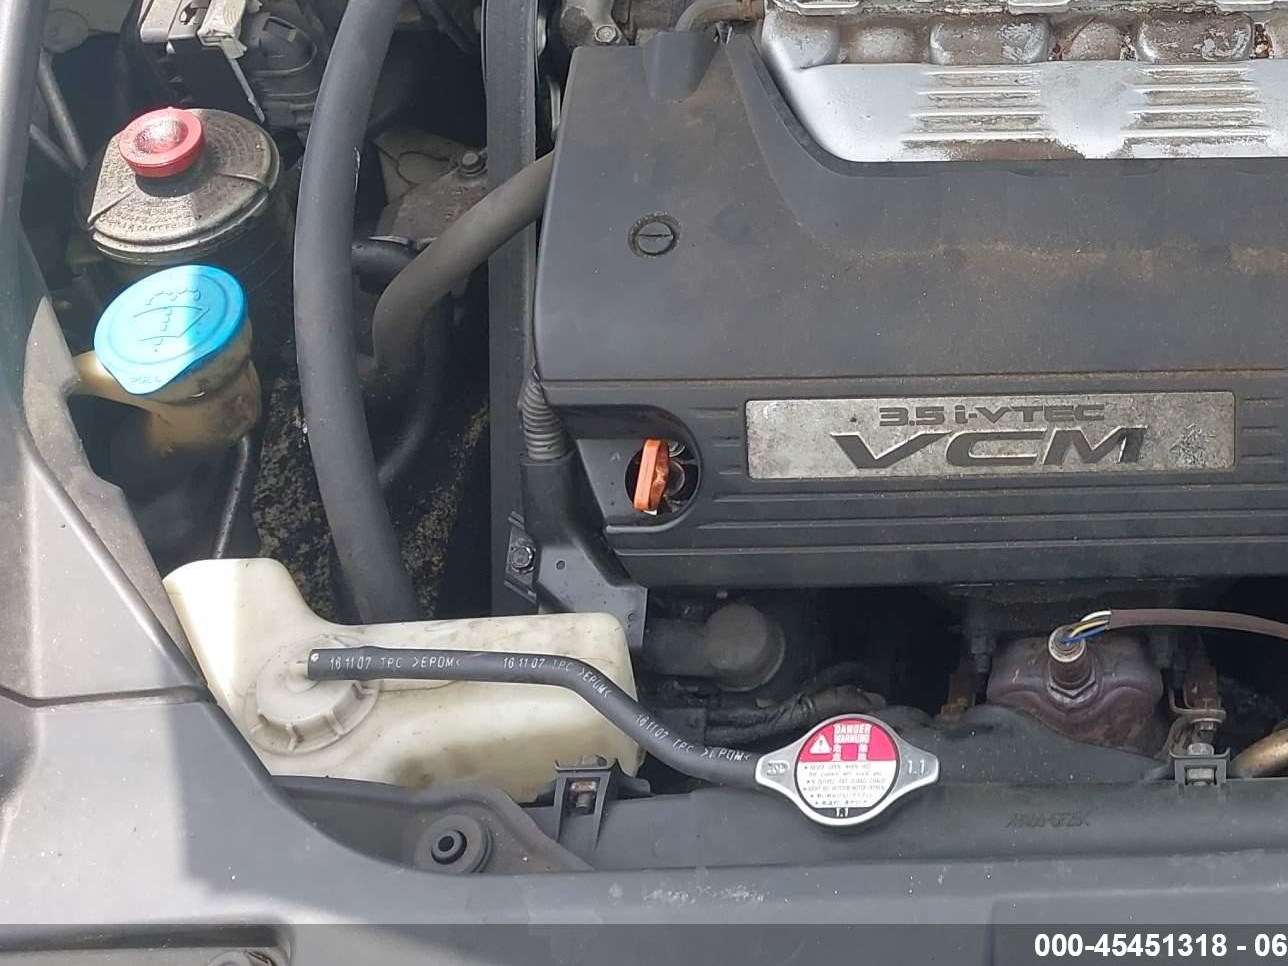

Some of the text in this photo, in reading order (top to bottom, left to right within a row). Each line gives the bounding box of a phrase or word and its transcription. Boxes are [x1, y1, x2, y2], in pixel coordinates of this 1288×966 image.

[879, 403, 1105, 426] 3.5 i-VTEC
[831, 424, 1148, 470] VCM
[834, 724, 872, 734] DANGER
[908, 760, 925, 774] 1.1
[836, 807, 848, 818] 1.1
